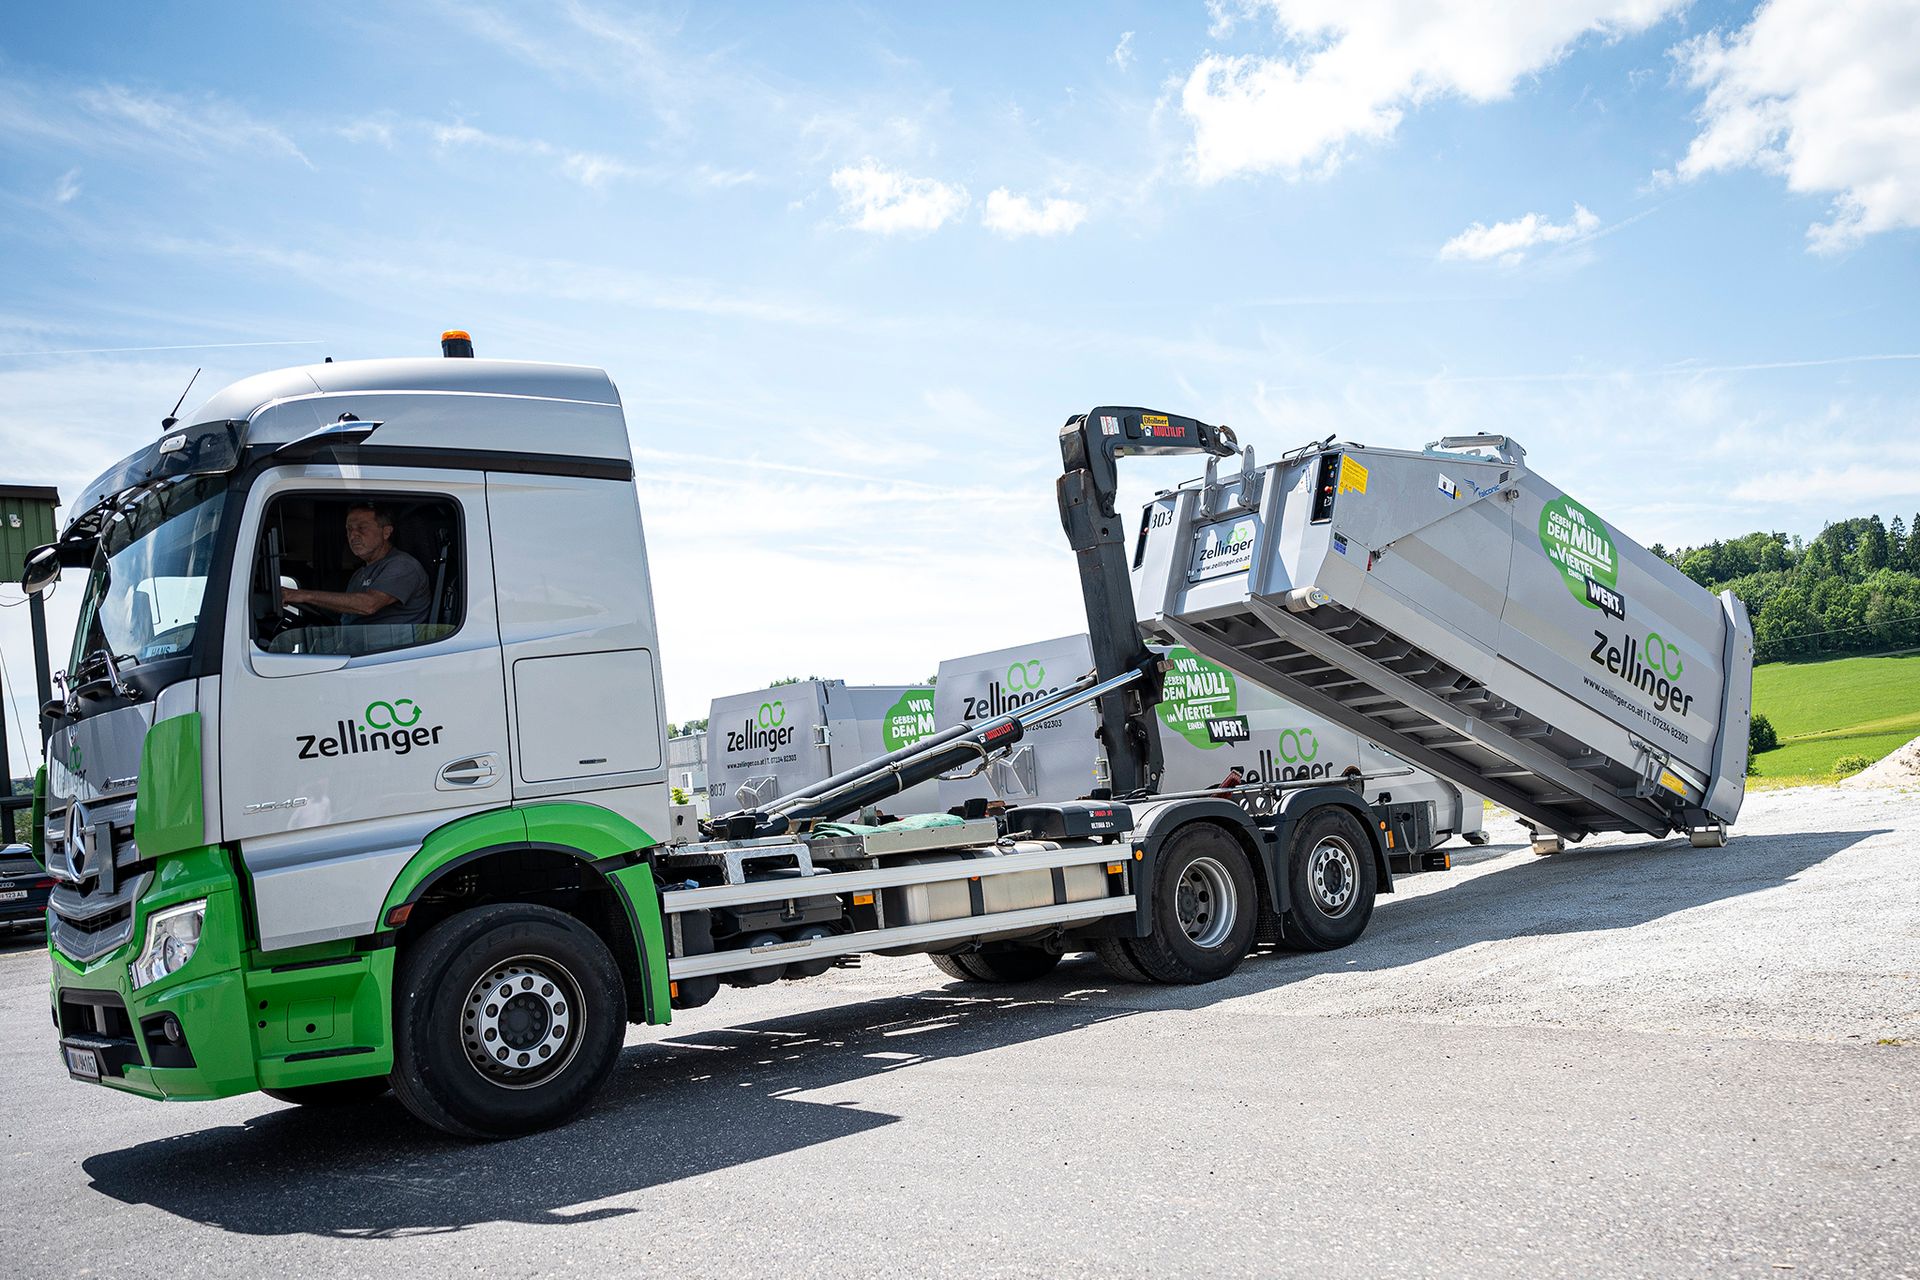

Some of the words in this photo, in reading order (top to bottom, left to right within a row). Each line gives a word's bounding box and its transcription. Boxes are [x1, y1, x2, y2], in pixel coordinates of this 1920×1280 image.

[1153, 426, 1185, 438] MULTILIFT
[1549, 511, 1571, 530] GEBEN
[1565, 503, 1587, 527] WIR
[1547, 521, 1569, 544] DEM
[1570, 523, 1612, 565] MÜLL
[1549, 548, 1559, 560] IM
[1588, 580, 1623, 615] WERT.
[151, 646, 170, 656] HANS
[1174, 658, 1199, 672] WIR
[1162, 687, 1185, 702] DEM
[1186, 666, 1230, 697] MÜLL
[907, 699, 933, 712] WIR
[1583, 676, 1643, 717] www.zellinger.co.at
[1652, 716, 1671, 733] 07234
[1671, 727, 1689, 744] 82303
[892, 715, 917, 725] GEBEN
[1044, 719, 1062, 728] 82303
[1167, 713, 1177, 723] IM
[891, 724, 917, 738] DEM
[984, 722, 1015, 740] MULTILIFT
[1187, 721, 1205, 731] EINEN
[1209, 720, 1247, 738] WERT.
[709, 782, 726, 797] 8037
